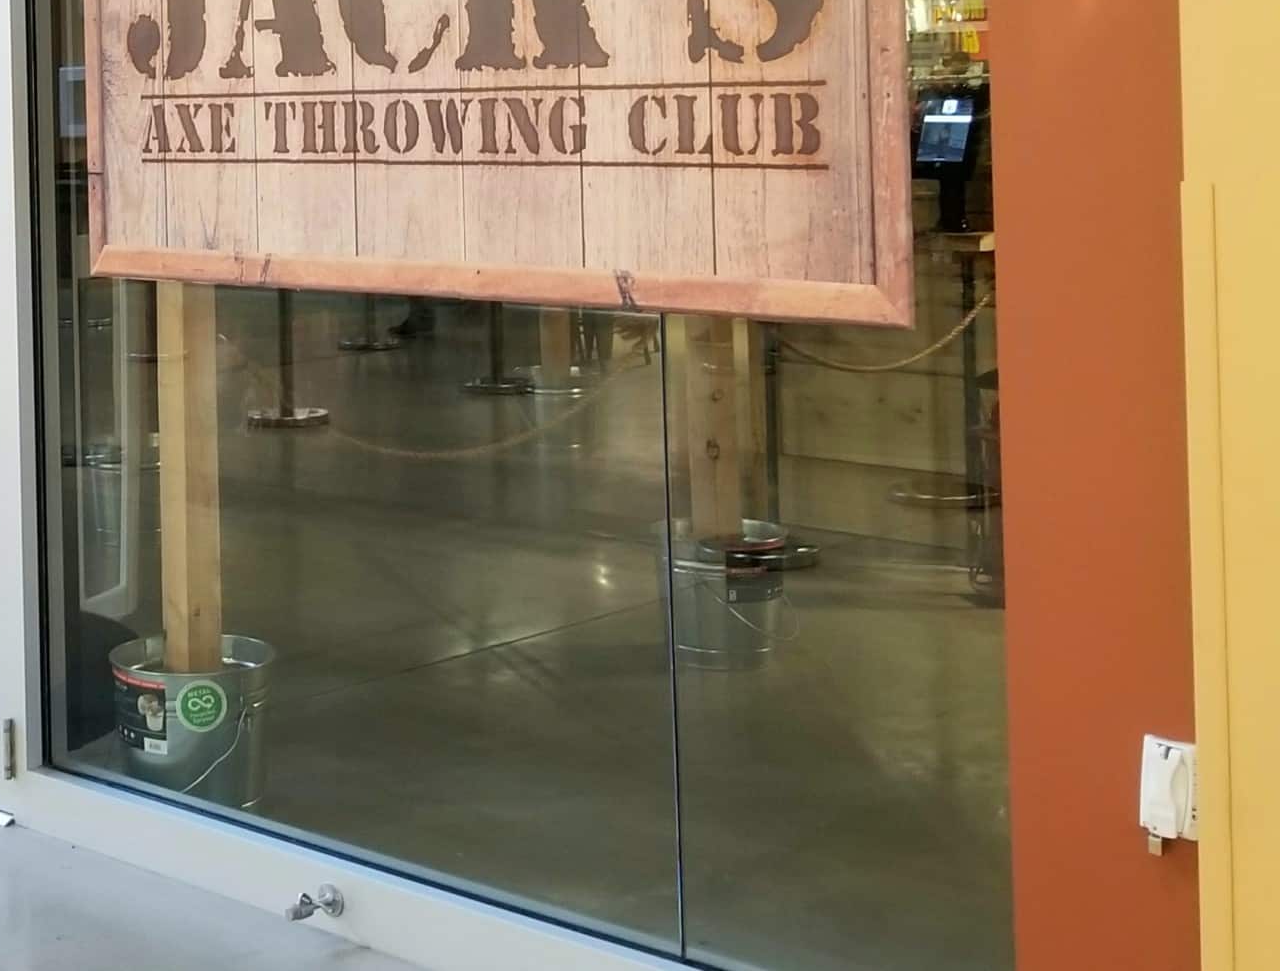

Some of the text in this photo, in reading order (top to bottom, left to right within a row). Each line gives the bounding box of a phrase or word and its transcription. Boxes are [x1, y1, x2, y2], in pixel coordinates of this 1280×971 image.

[141, 90, 823, 157] AXE THROWING CLUB
